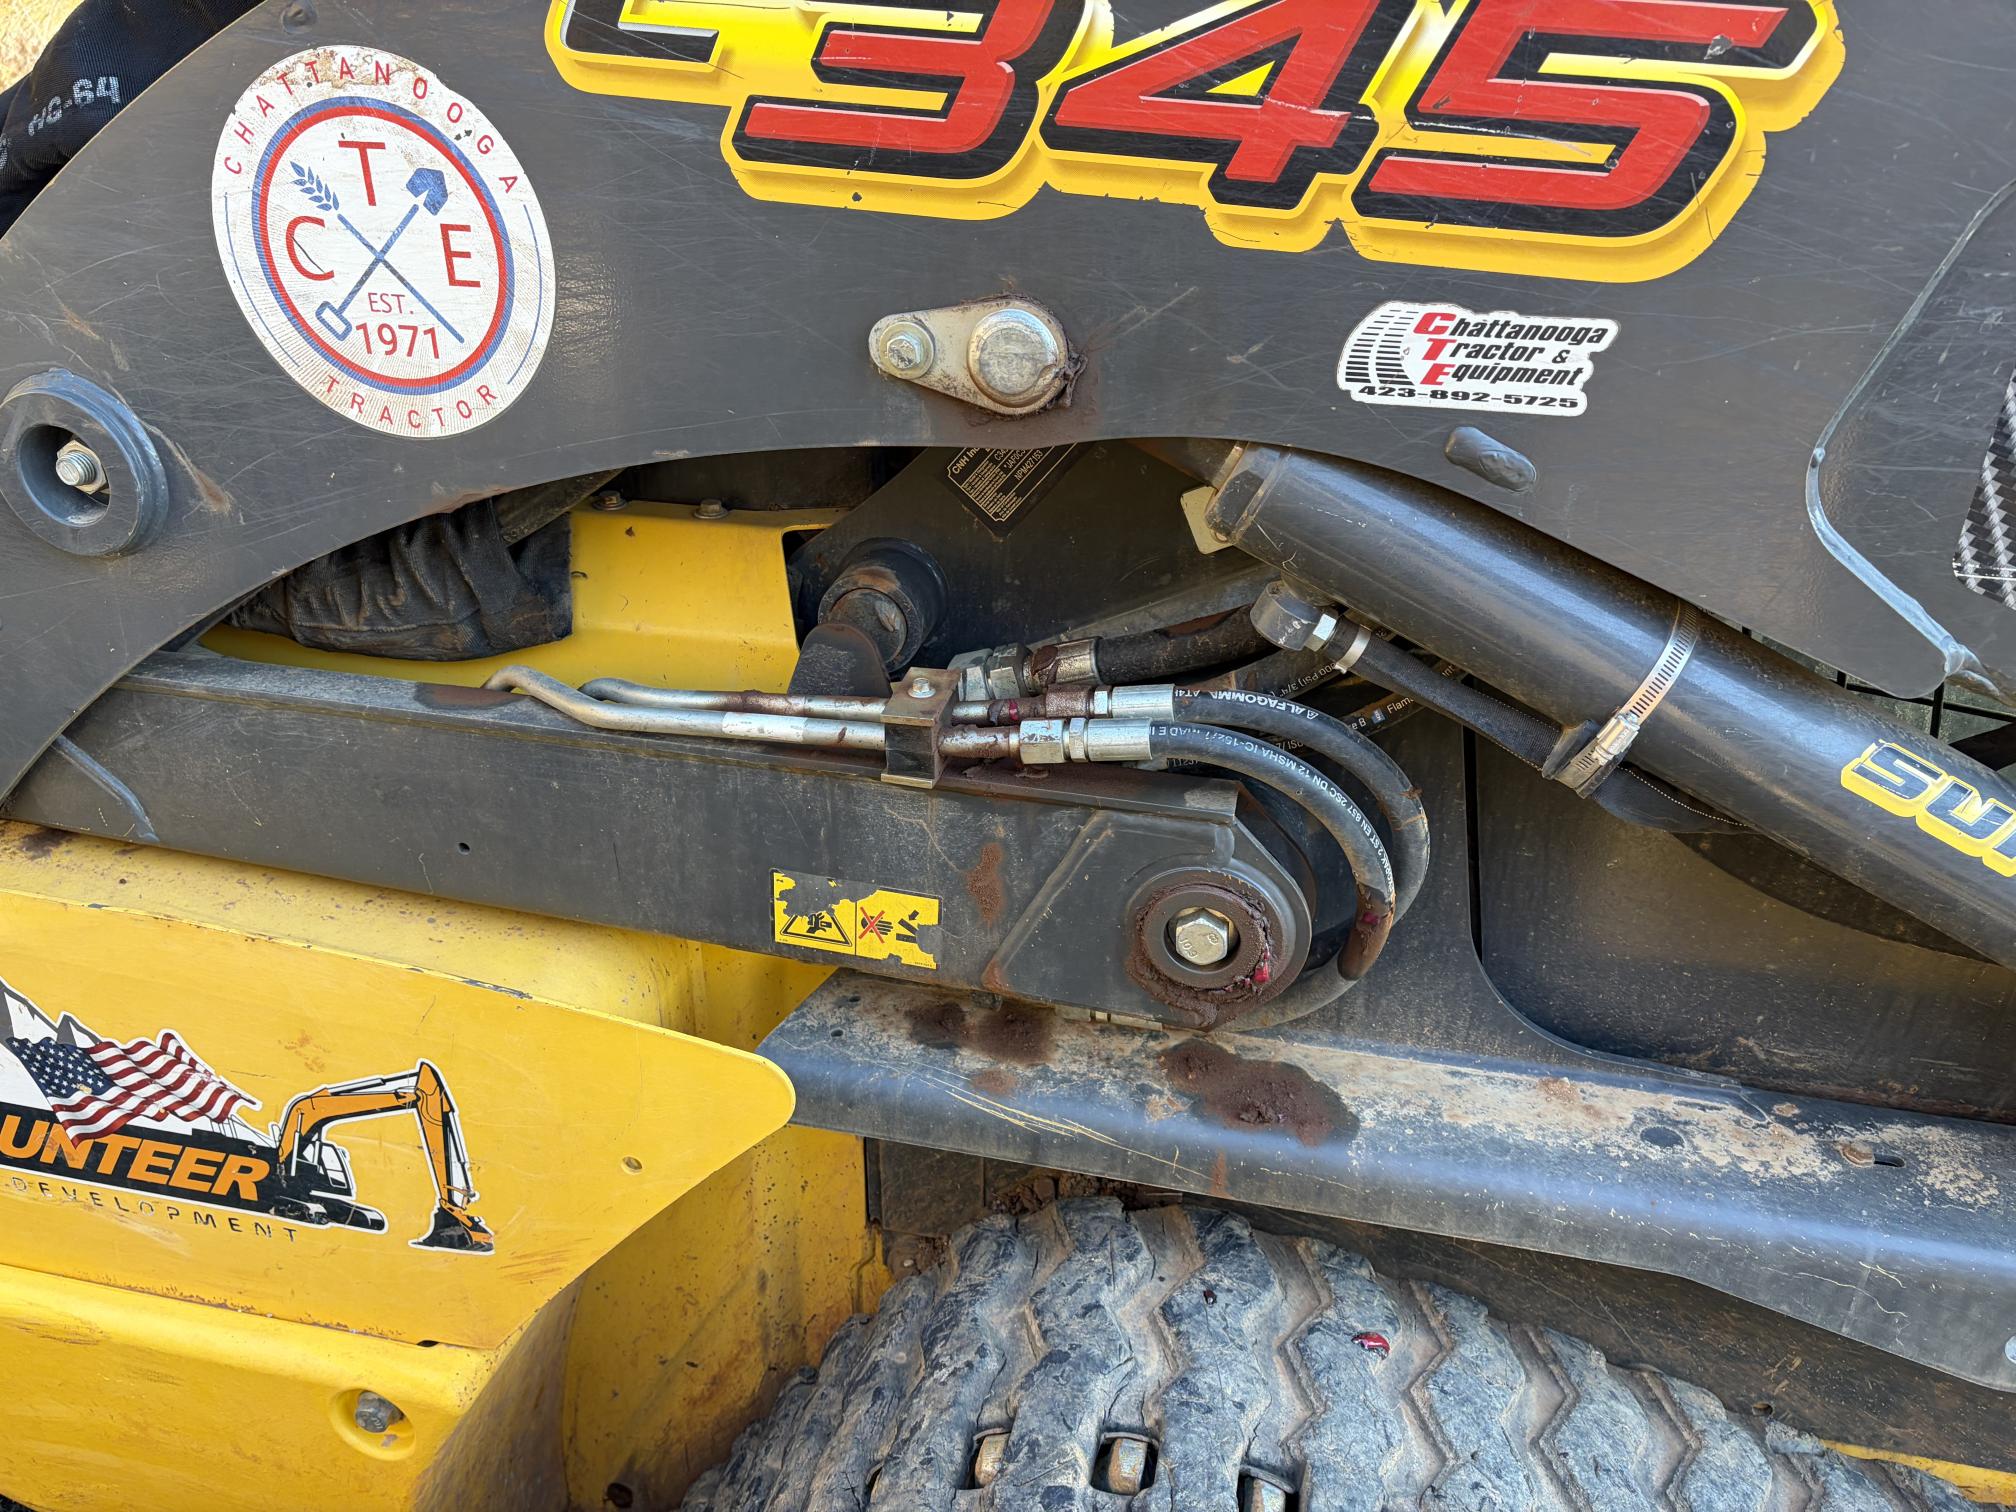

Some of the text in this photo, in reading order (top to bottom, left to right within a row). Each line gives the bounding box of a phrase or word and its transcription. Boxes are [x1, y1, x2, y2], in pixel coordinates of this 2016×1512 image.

[27, 76, 121, 137] HG-64
[224, 56, 518, 195] CHATTANOOGA
[548, 0, 1842, 262] 345
[338, 140, 386, 207] T
[285, 215, 481, 288] C E
[368, 291, 415, 316] EST.
[355, 322, 440, 360] 1971
[1413, 312, 1608, 345] Chattanooga
[1422, 338, 1571, 364] Tractor &
[1420, 362, 1584, 387] Equipment
[322, 374, 498, 428] TRACTOR
[1357, 385, 1579, 409] 423-892-5725
[952, 457, 970, 474] CNH
[1261, 747, 1297, 771] MSHA
[1298, 765, 1311, 778] 12
[1312, 774, 1329, 791] DN
[1329, 787, 1348, 807] 2SC
[1346, 804, 1362, 823] 857
[11, 1176, 300, 1242] DEVELOPMENT
